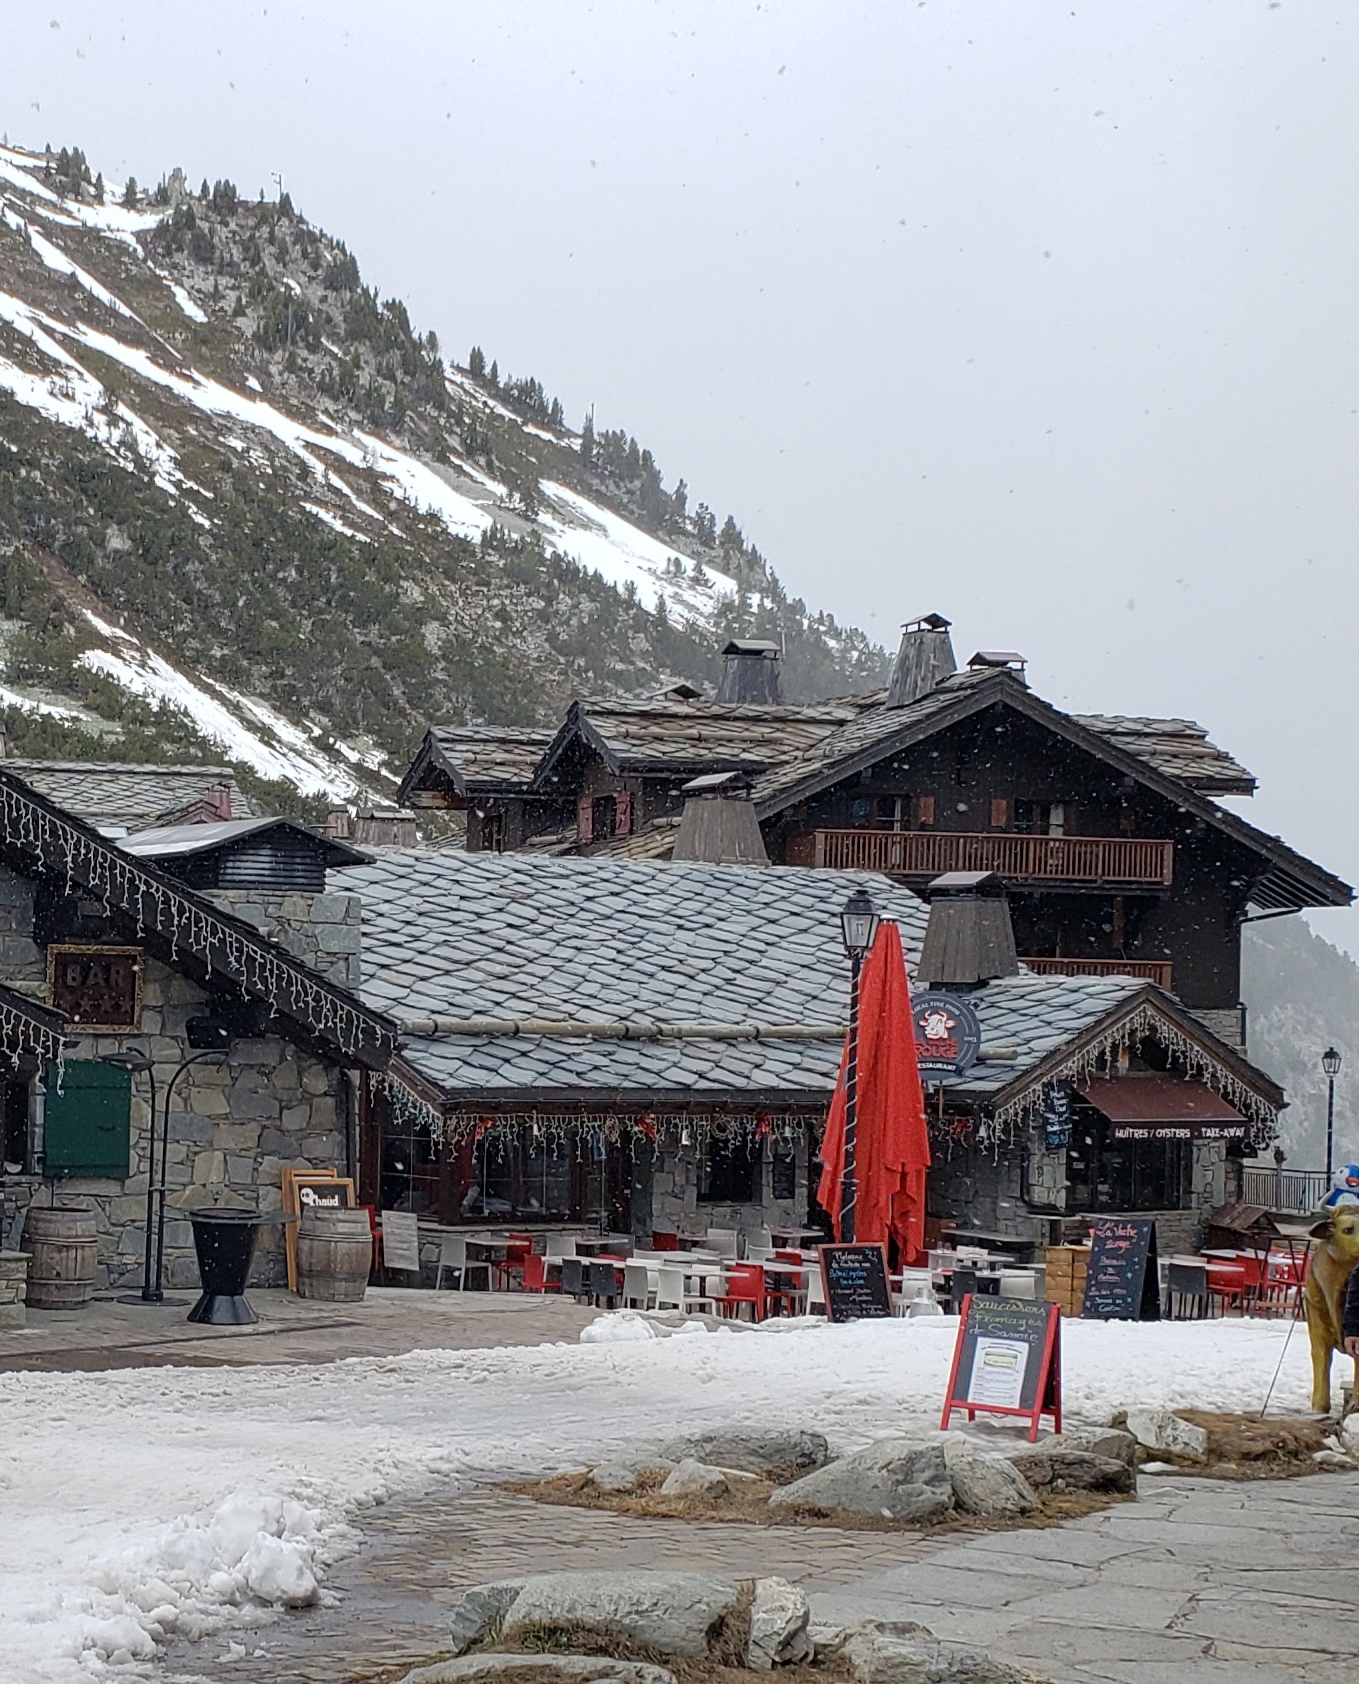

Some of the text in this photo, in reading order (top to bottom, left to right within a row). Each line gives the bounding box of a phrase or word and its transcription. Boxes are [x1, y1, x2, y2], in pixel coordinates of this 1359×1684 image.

[66, 963, 125, 986] BAR
[917, 1062, 957, 1071] ESTAURANT
[1155, 1128, 1191, 1138] OYSTERS
[1201, 1126, 1245, 1138] TAKE-AWAY
